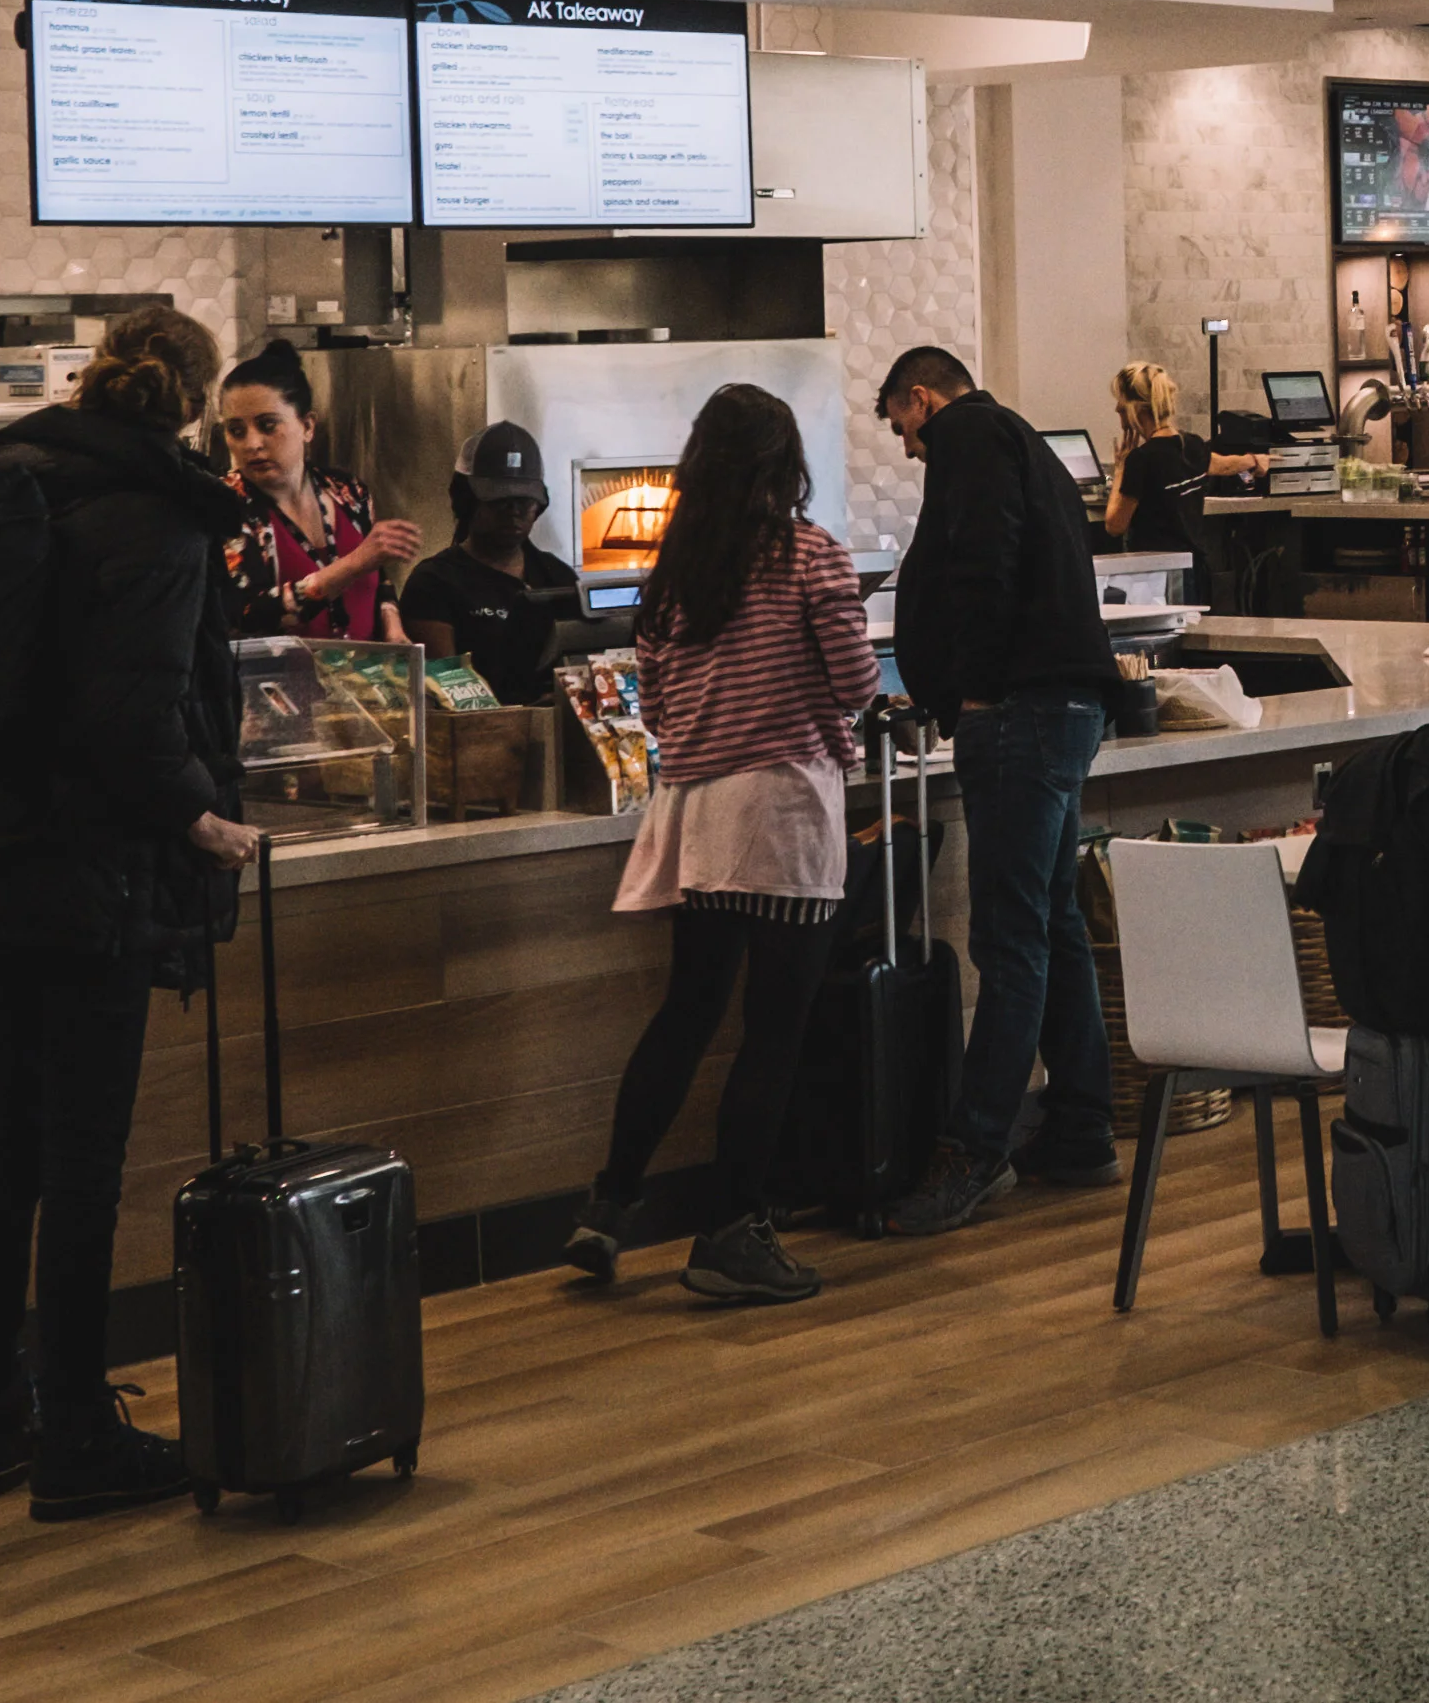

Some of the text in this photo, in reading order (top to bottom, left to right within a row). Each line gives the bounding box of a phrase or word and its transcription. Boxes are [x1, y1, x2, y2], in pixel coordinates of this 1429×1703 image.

[527, 0, 644, 27] AK Takeaway
[477, 94, 500, 104] and
